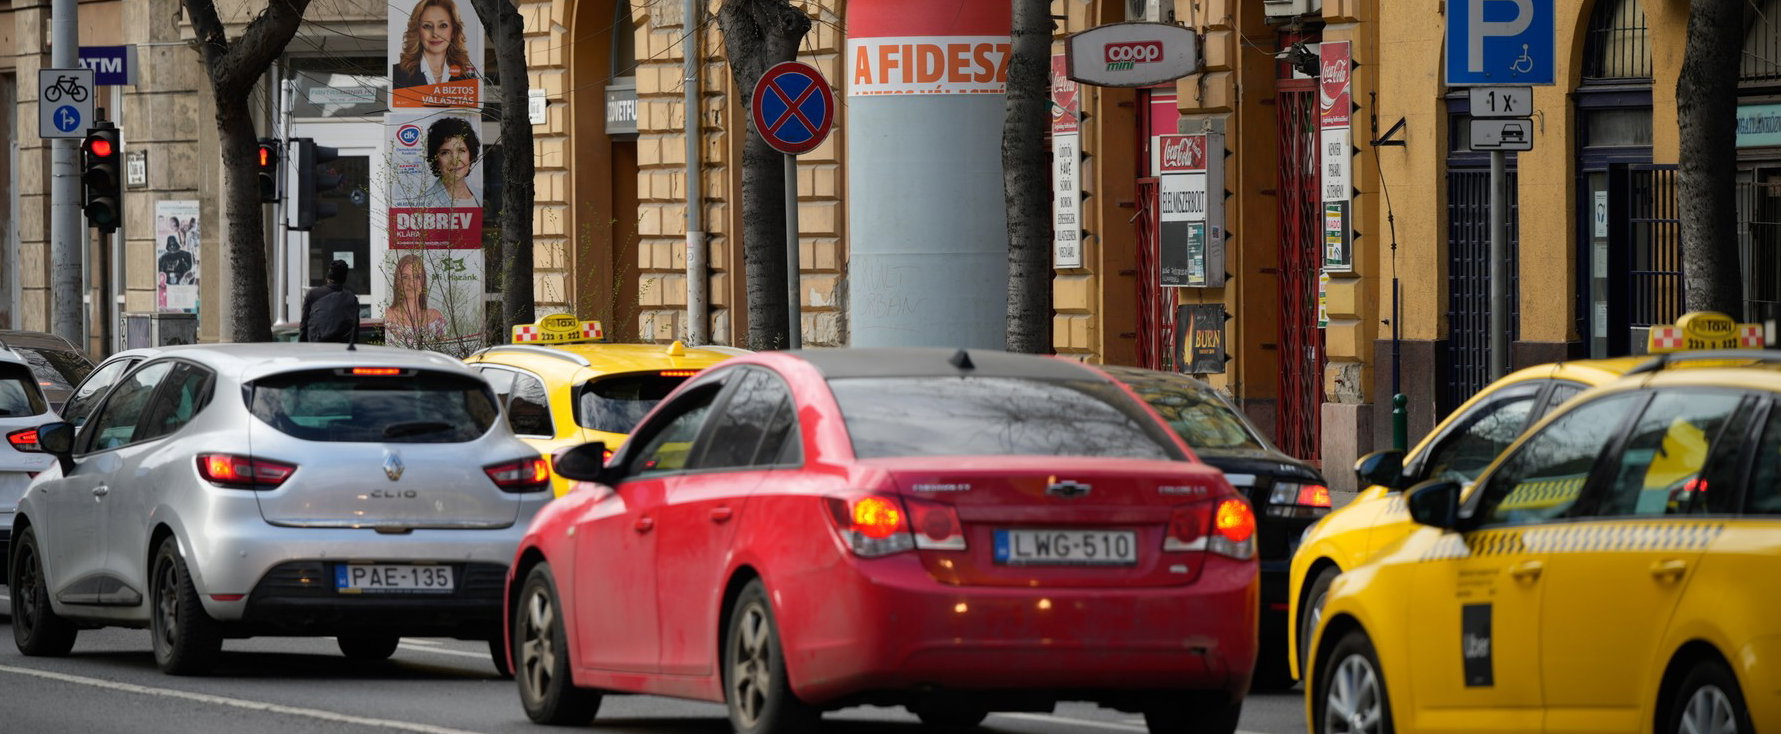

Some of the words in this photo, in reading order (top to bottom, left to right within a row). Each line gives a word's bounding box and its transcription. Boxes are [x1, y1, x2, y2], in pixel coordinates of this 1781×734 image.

[1108, 44, 1159, 63] coop
[855, 45, 873, 85] A
[1106, 57, 1135, 72] mini
[433, 86, 440, 94] A
[442, 86, 474, 94] BIZTOS
[421, 93, 474, 105] VÁLASZTÁS
[1489, 91, 1495, 112] 1
[403, 130, 415, 139] dk
[396, 213, 472, 229] DOBREV
[396, 230, 420, 238] KLÁRA
[1195, 329, 1221, 348] BURN
[371, 490, 417, 498] CLIO
[1014, 534, 1129, 558] LWG-510
[352, 567, 448, 586] PAE-135
